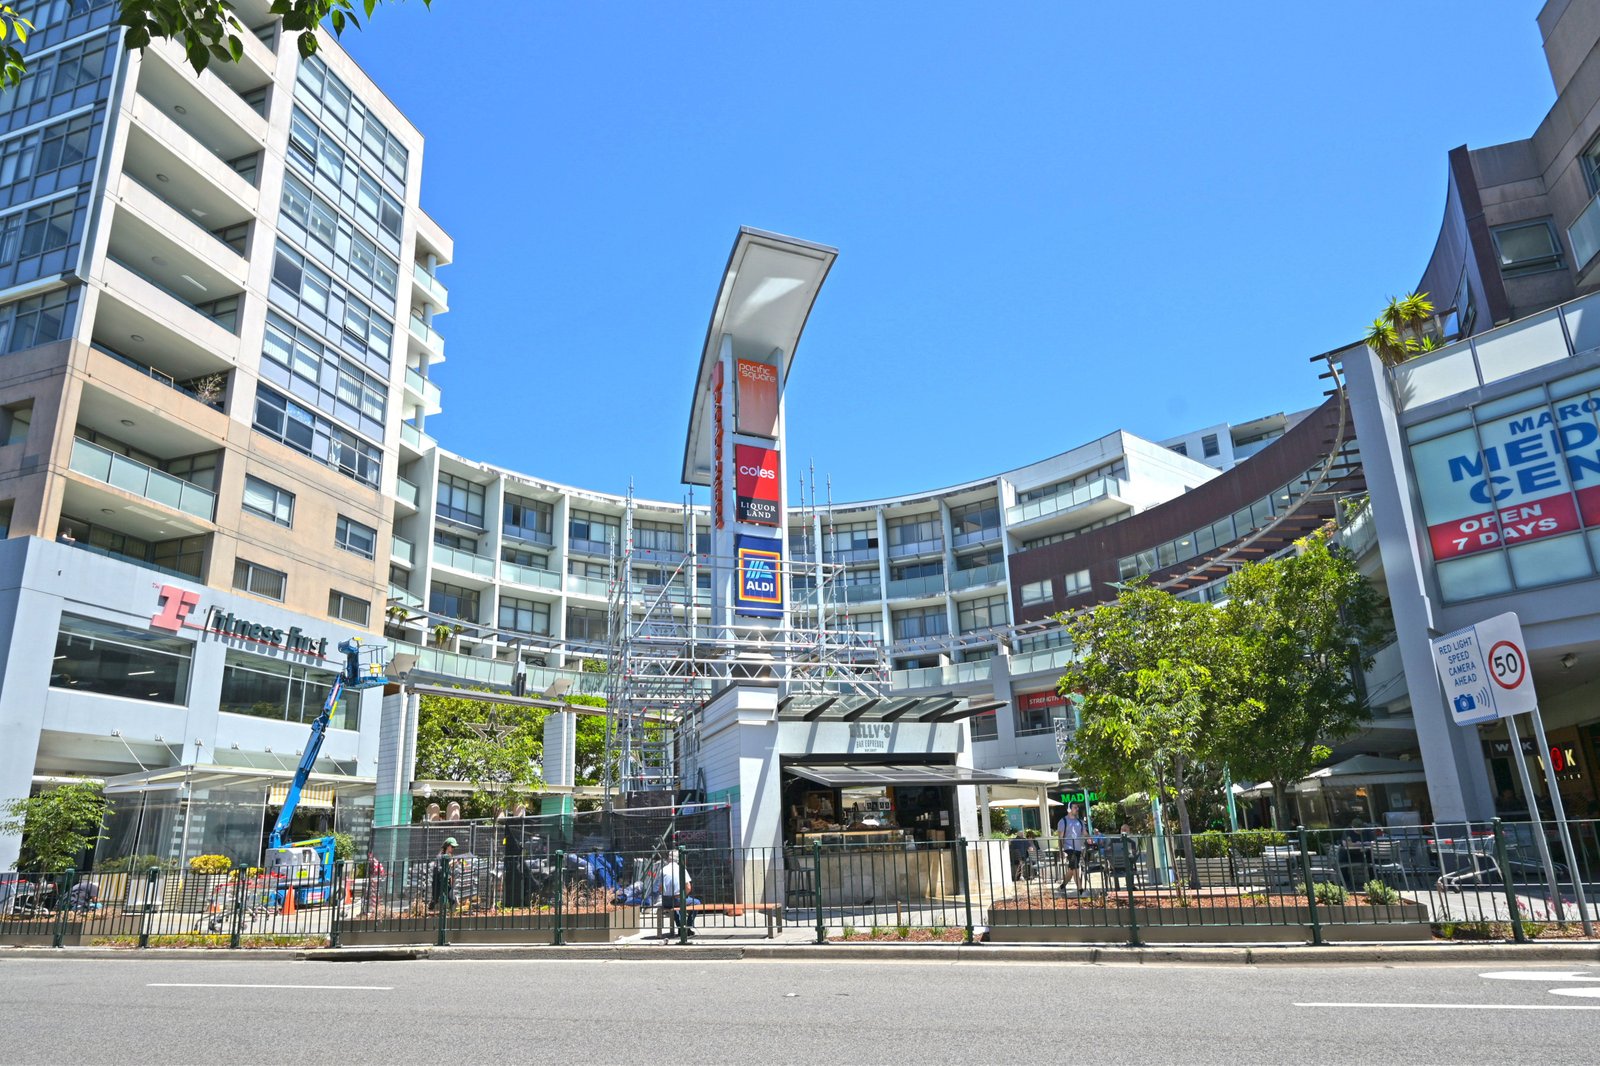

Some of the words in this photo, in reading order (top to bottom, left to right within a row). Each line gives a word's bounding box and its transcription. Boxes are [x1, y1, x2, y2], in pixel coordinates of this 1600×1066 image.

[739, 363, 770, 375] pacific
[742, 370, 776, 382] square
[740, 465, 775, 479] coles
[740, 501, 776, 512] LIQUOR
[746, 509, 771, 519] LAND
[1459, 504, 1543, 533] OPEN
[1452, 537, 1469, 551] 7
[1479, 518, 1559, 545] DAYS
[746, 580, 774, 592] ALDI
[205, 604, 284, 645] Fitness
[286, 625, 329, 658] First
[1438, 644, 1452, 656] RED
[1453, 637, 1474, 651] LIGHT
[1447, 650, 1470, 664] SPEED
[1448, 662, 1477, 677] CAMERA
[1494, 653, 1518, 677] 50
[1454, 673, 1478, 687] AHEAD
[1029, 695, 1060, 705] STRENGTH
[1495, 741, 1533, 752] WK
[1061, 793, 1084, 803] MAD
